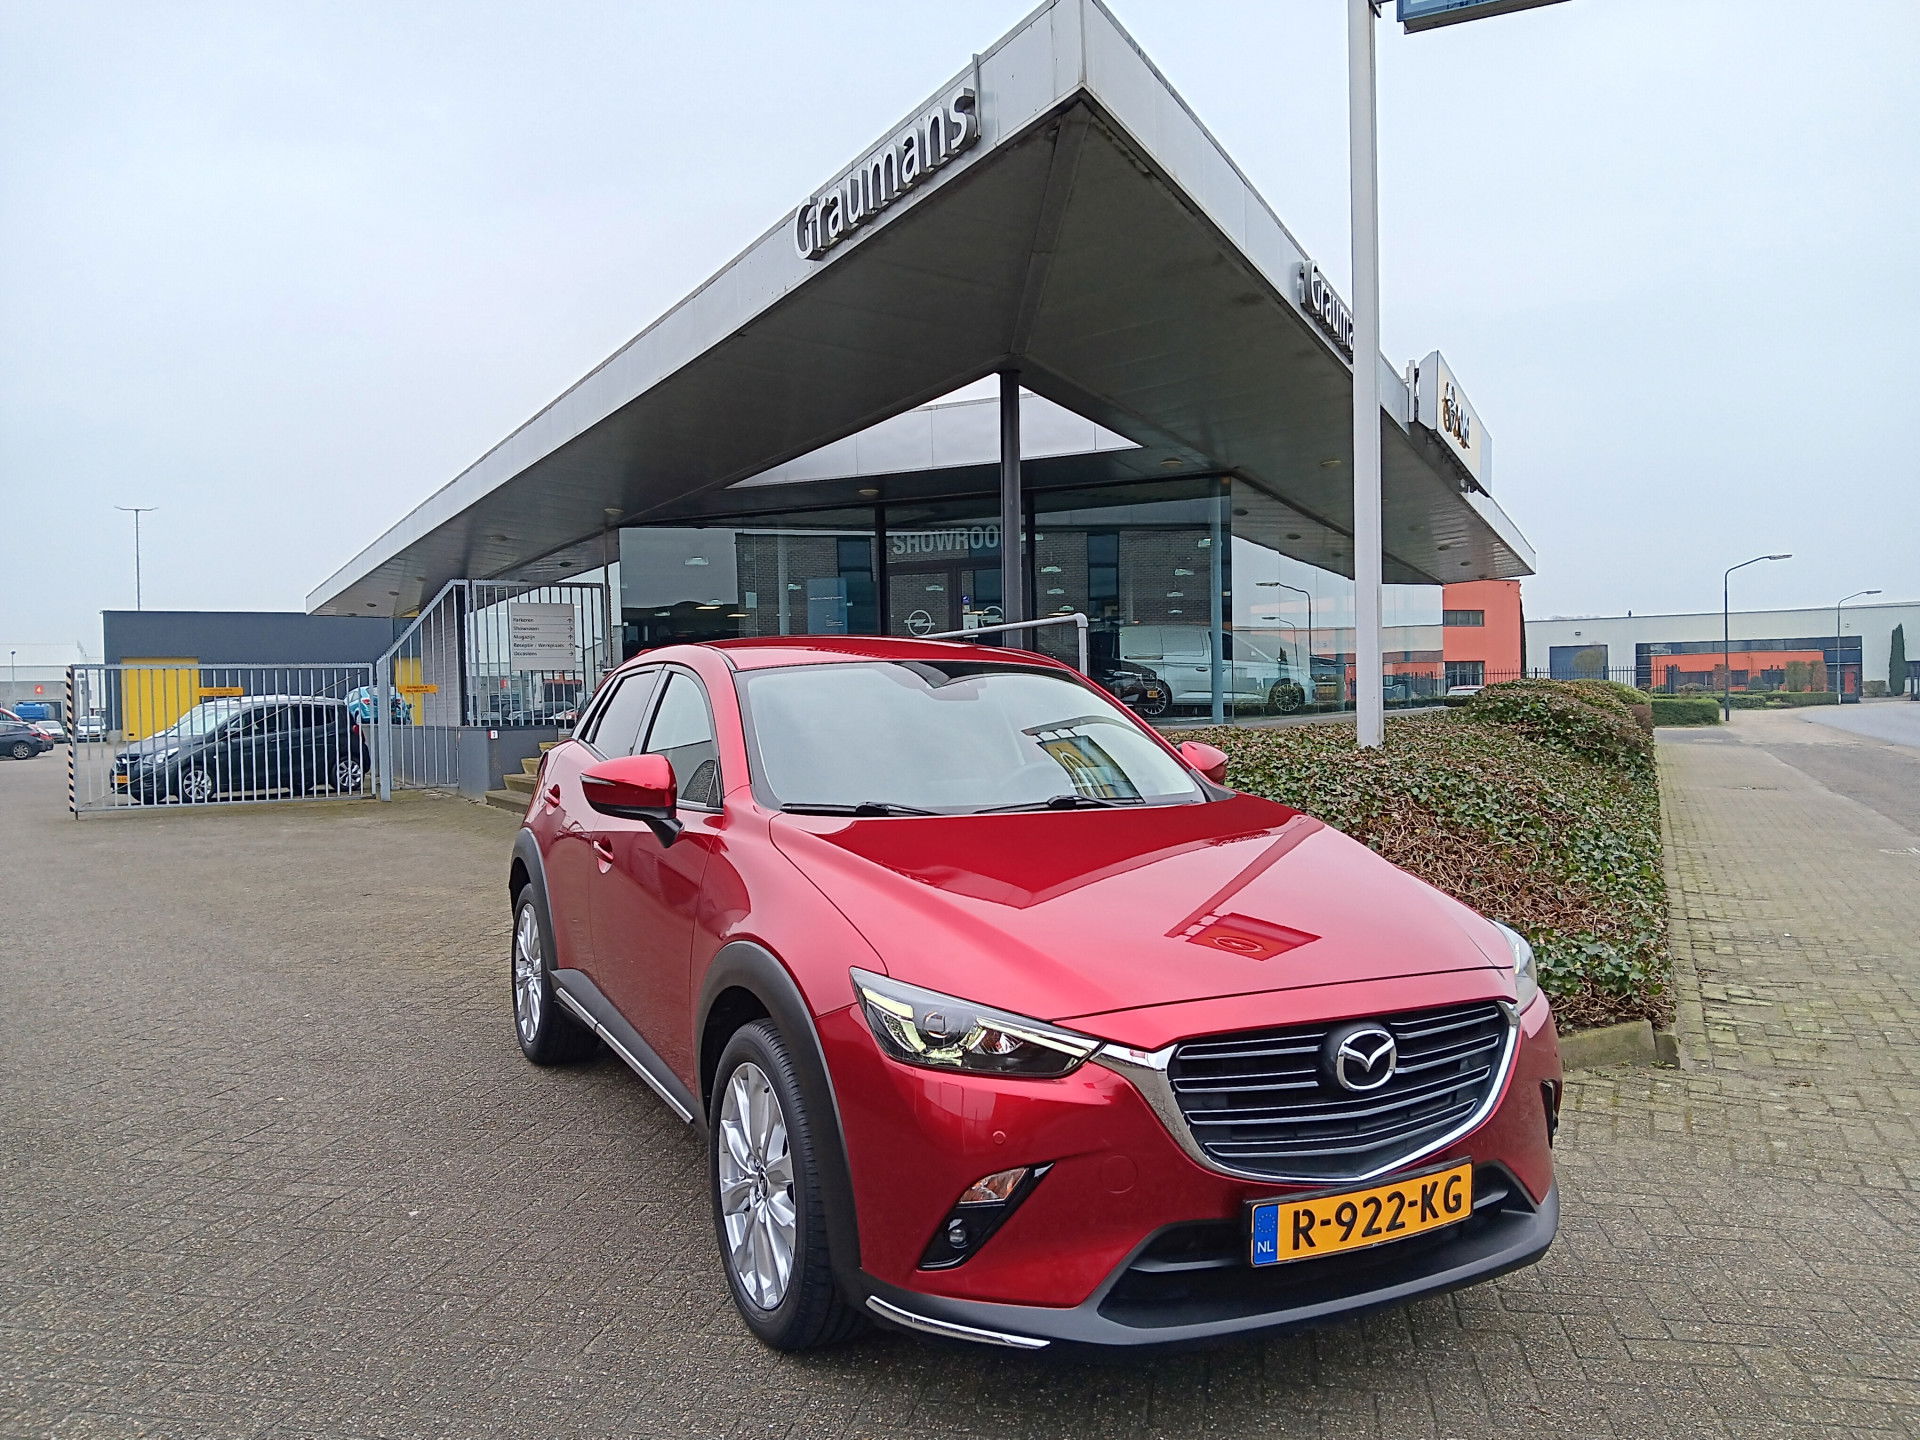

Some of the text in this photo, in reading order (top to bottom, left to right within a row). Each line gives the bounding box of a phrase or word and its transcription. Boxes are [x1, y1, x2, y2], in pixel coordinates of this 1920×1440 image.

[793, 87, 977, 260] Graumans
[1305, 259, 1354, 352] Grauma
[892, 525, 999, 555] SHOWROO
[1257, 1241, 1274, 1254] NL
[1292, 1175, 1462, 1251] R-922-KG
